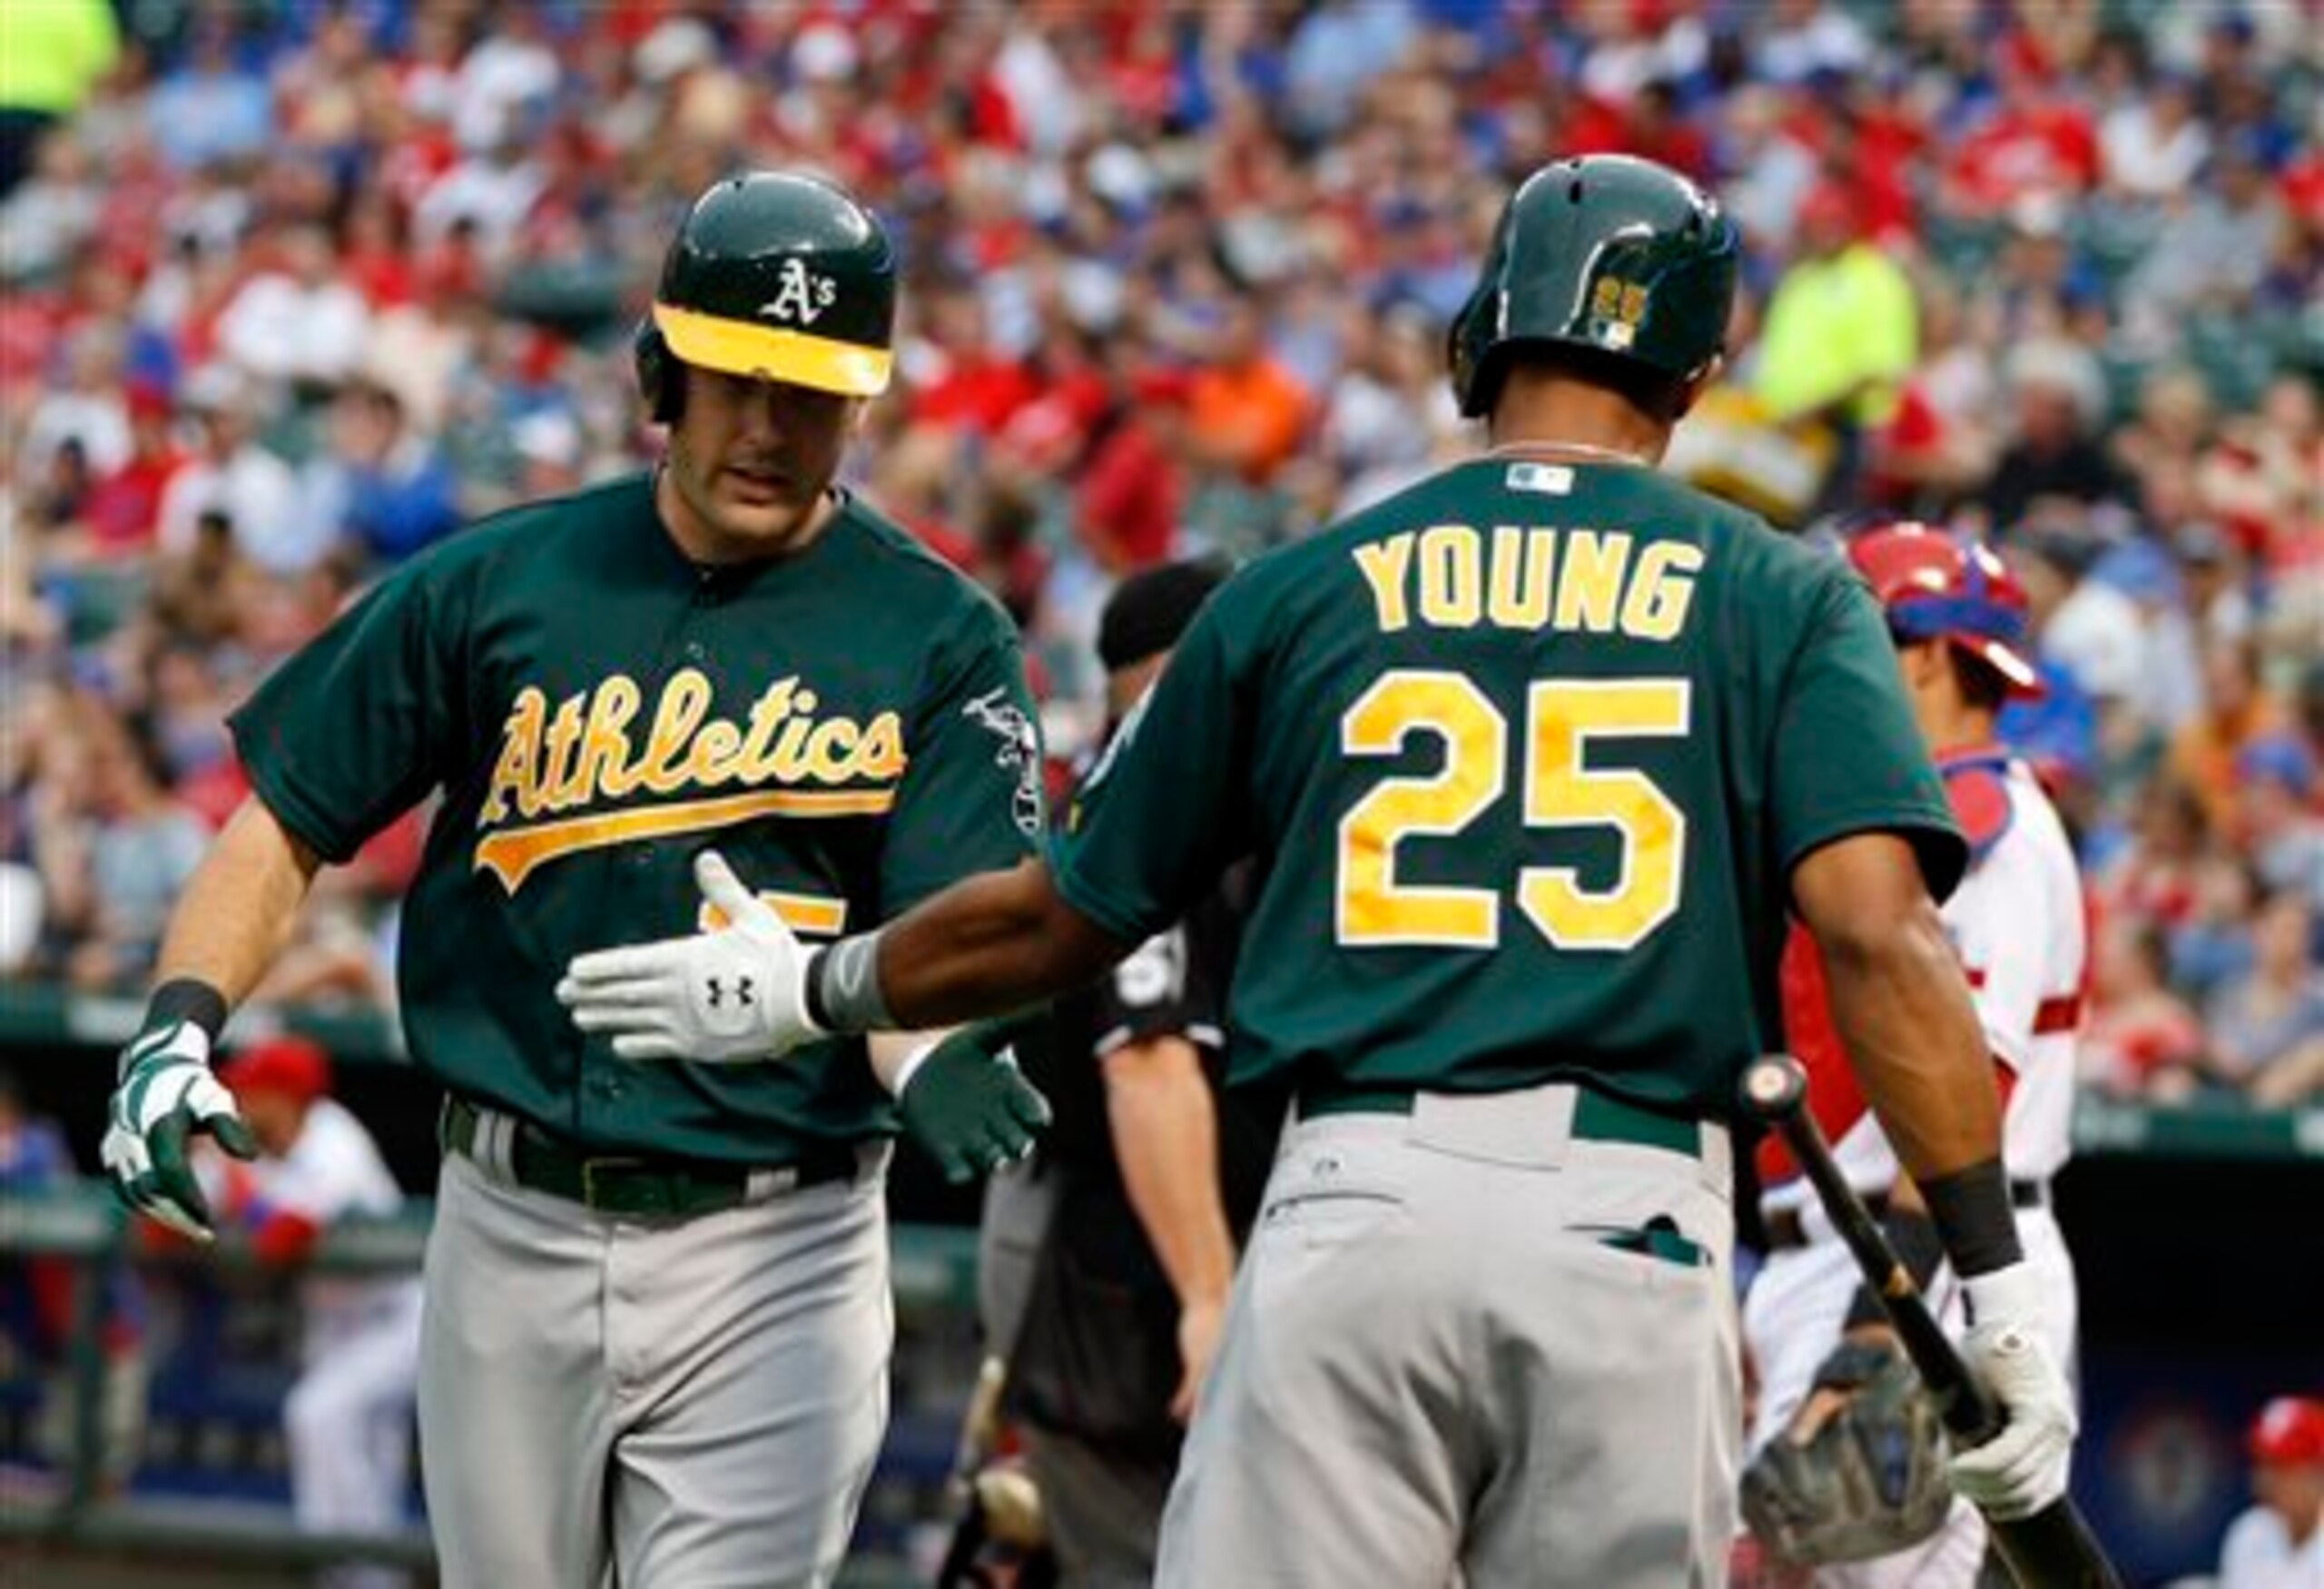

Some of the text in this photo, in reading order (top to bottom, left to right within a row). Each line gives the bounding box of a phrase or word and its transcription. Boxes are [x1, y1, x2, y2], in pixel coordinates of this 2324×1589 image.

[758, 258, 837, 324] A's
[1352, 525, 1707, 641] YOUNG
[477, 667, 908, 827] Athletics
[1335, 670, 1692, 951] 25
